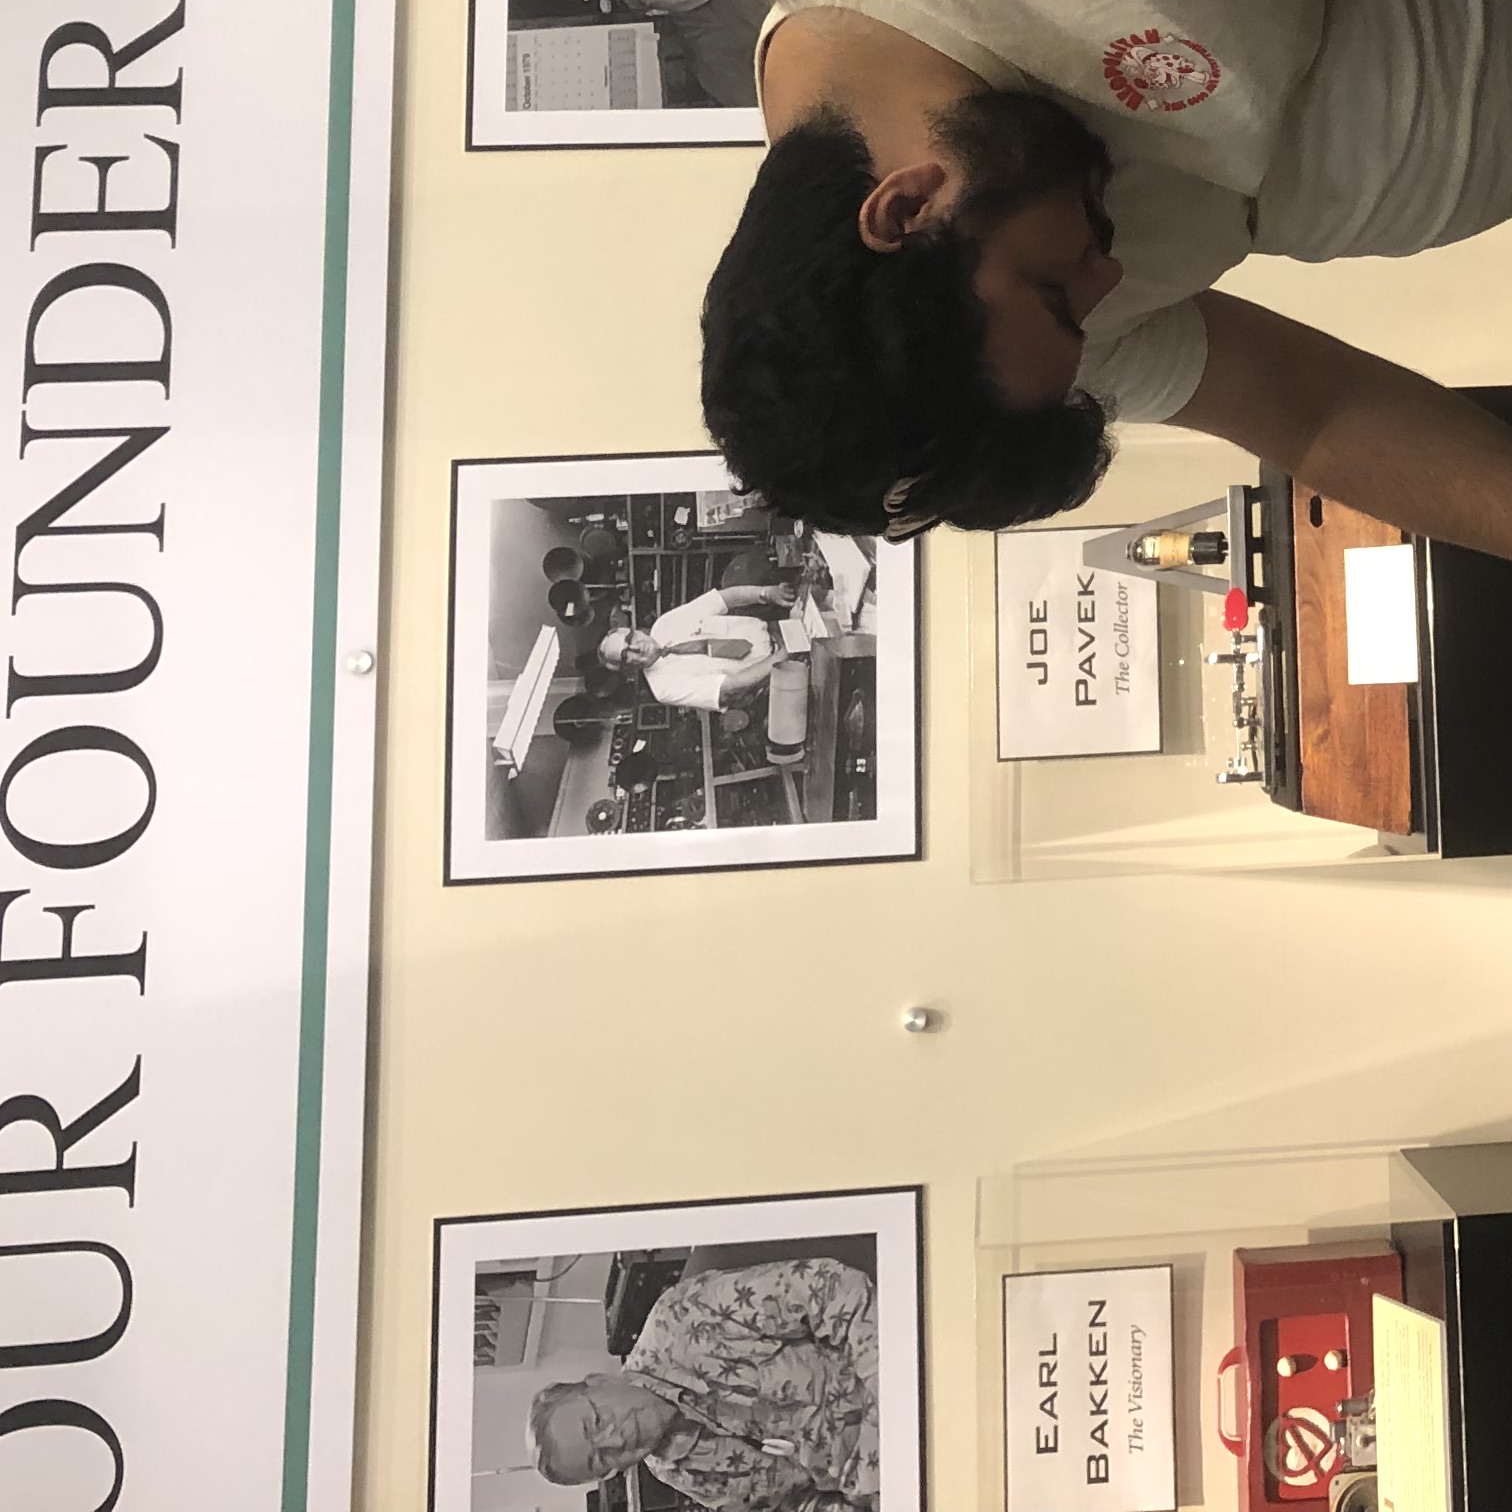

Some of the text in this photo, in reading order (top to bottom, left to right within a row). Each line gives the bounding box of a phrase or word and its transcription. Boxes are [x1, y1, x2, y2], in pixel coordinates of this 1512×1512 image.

[1114, 582, 1130, 696] The Collector
[0, 1055, 142, 1512] OUR
[1128, 1324, 1146, 1454] The Visionary
